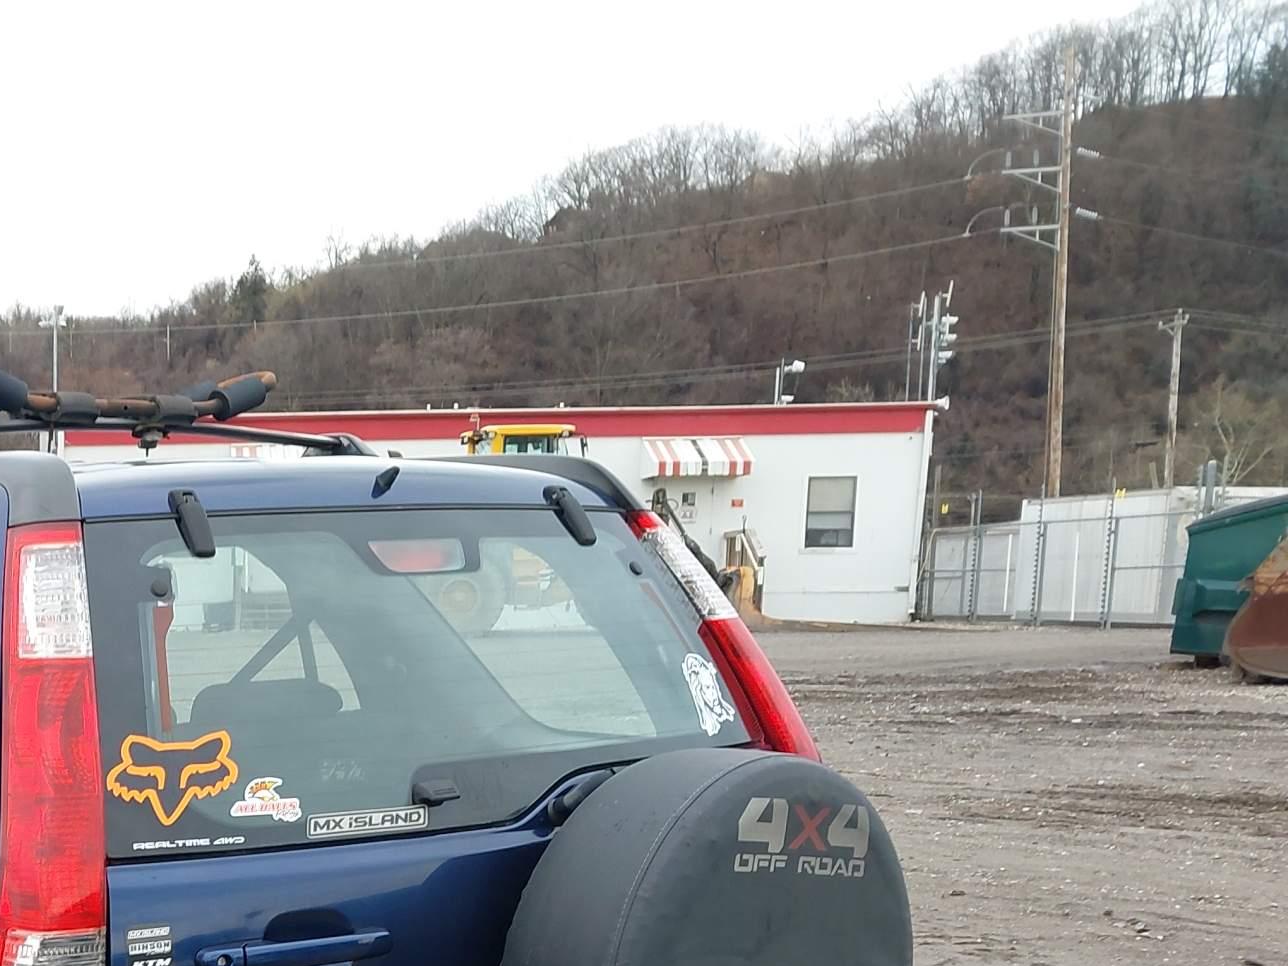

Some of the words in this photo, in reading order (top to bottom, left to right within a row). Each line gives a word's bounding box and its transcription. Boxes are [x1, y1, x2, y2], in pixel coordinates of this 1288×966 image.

[313, 816, 344, 832] MX
[738, 797, 870, 858] 4X4
[132, 838, 211, 850] REALTIME
[213, 836, 245, 846] 4WD
[734, 853, 788, 873] OFF
[797, 855, 866, 878] ROAD
